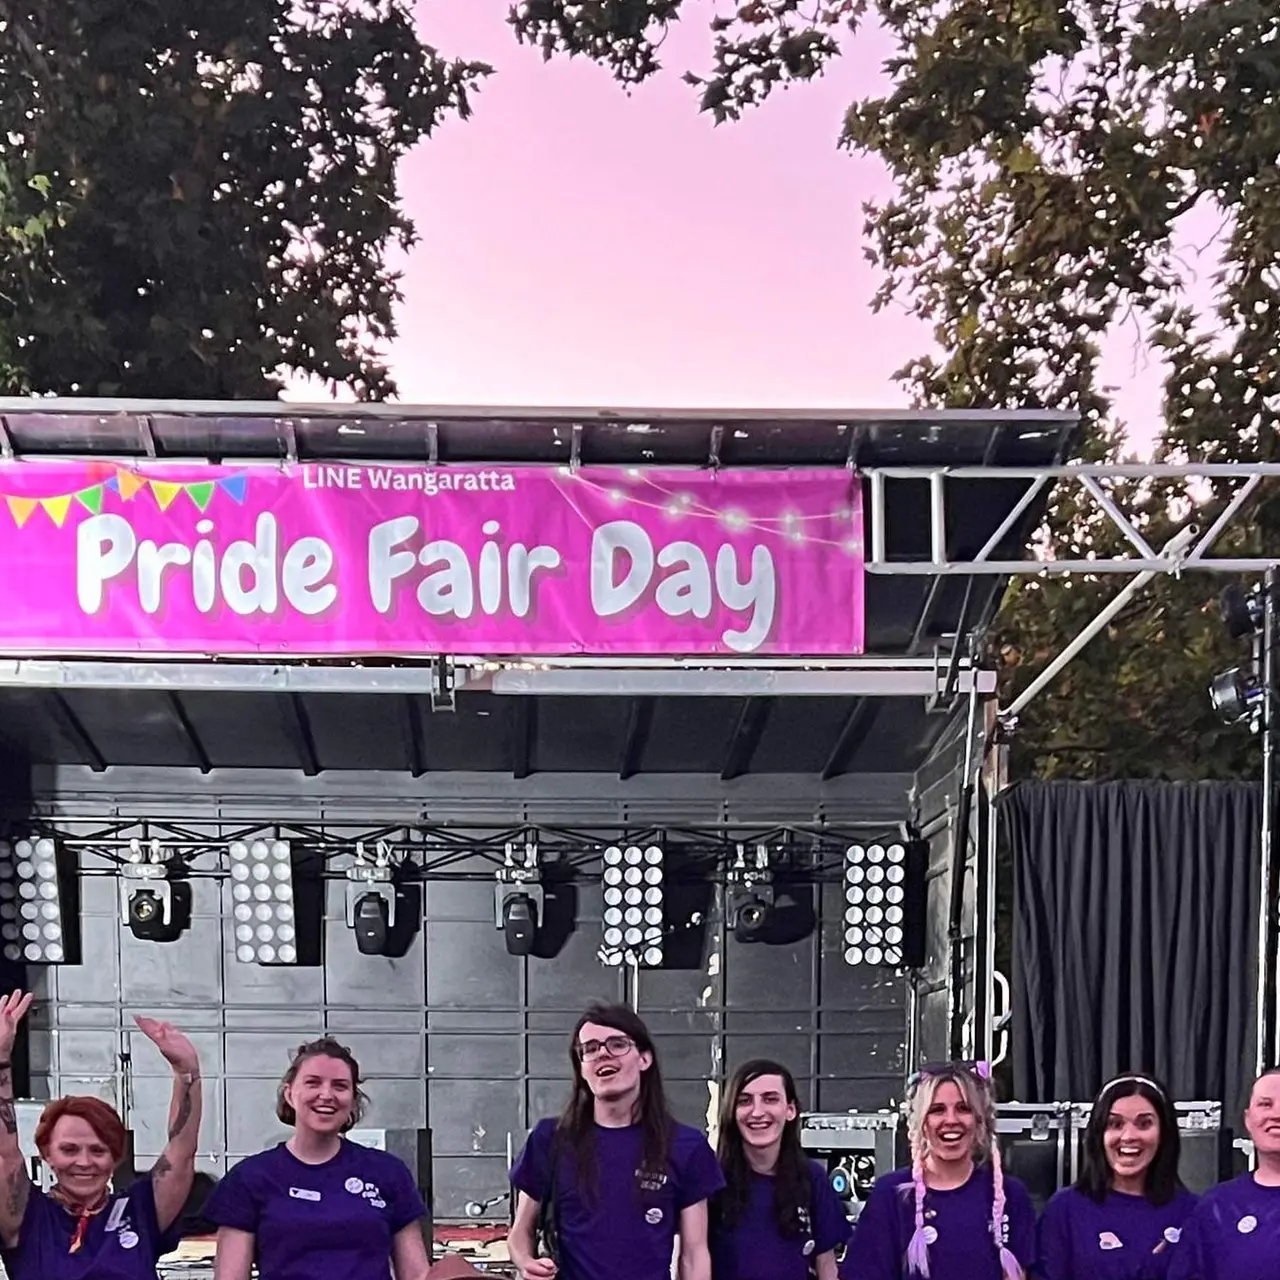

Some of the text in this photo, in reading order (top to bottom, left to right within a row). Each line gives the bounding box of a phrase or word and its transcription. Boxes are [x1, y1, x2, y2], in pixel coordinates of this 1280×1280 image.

[302, 467, 516, 496] LINE Wangaratta
[75, 511, 777, 653] Pride Fair Day
